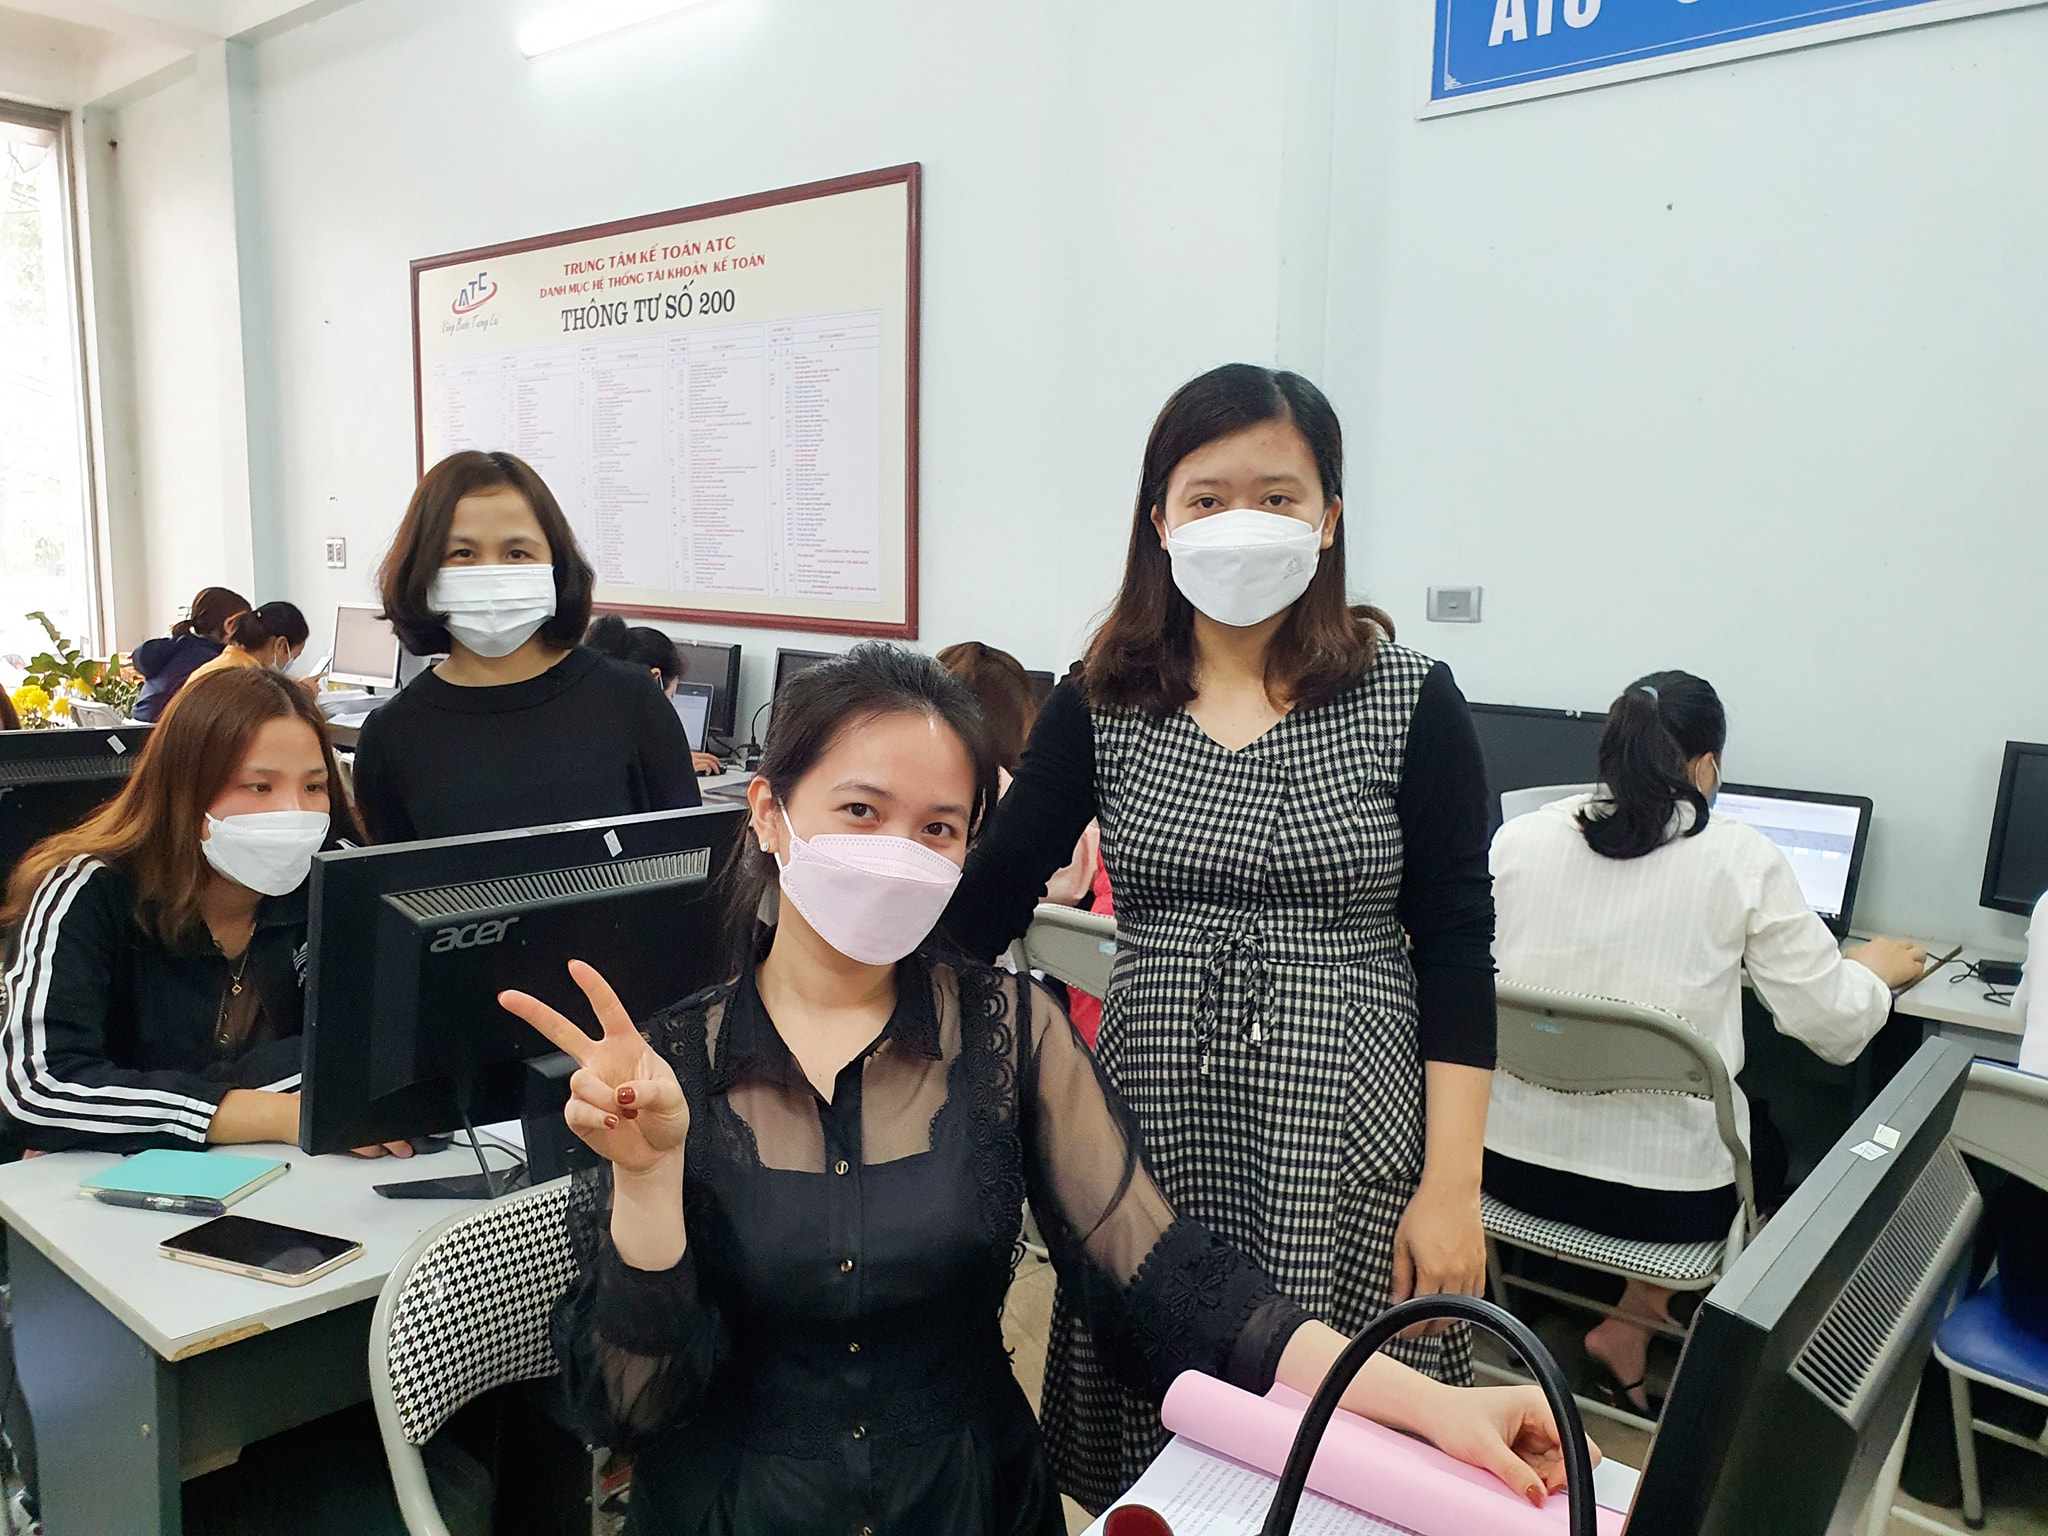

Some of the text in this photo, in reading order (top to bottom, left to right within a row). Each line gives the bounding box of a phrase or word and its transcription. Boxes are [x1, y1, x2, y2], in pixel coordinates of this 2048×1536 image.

[540, 285, 567, 299] DANH
[568, 281, 590, 296] MỤC
[592, 276, 604, 292] HỆ
[608, 270, 645, 288] THỐNG
[667, 260, 708, 279] KHOẢN
[713, 255, 729, 273] KẾ
[732, 252, 766, 270] TOÁN
[563, 235, 737, 276] TRUNG TÂM KẾ TOÁN ATC
[458, 271, 488, 307] ATC
[561, 279, 735, 332] THÔNG TƯ SỐ 200
[430, 916, 520, 953] acer
